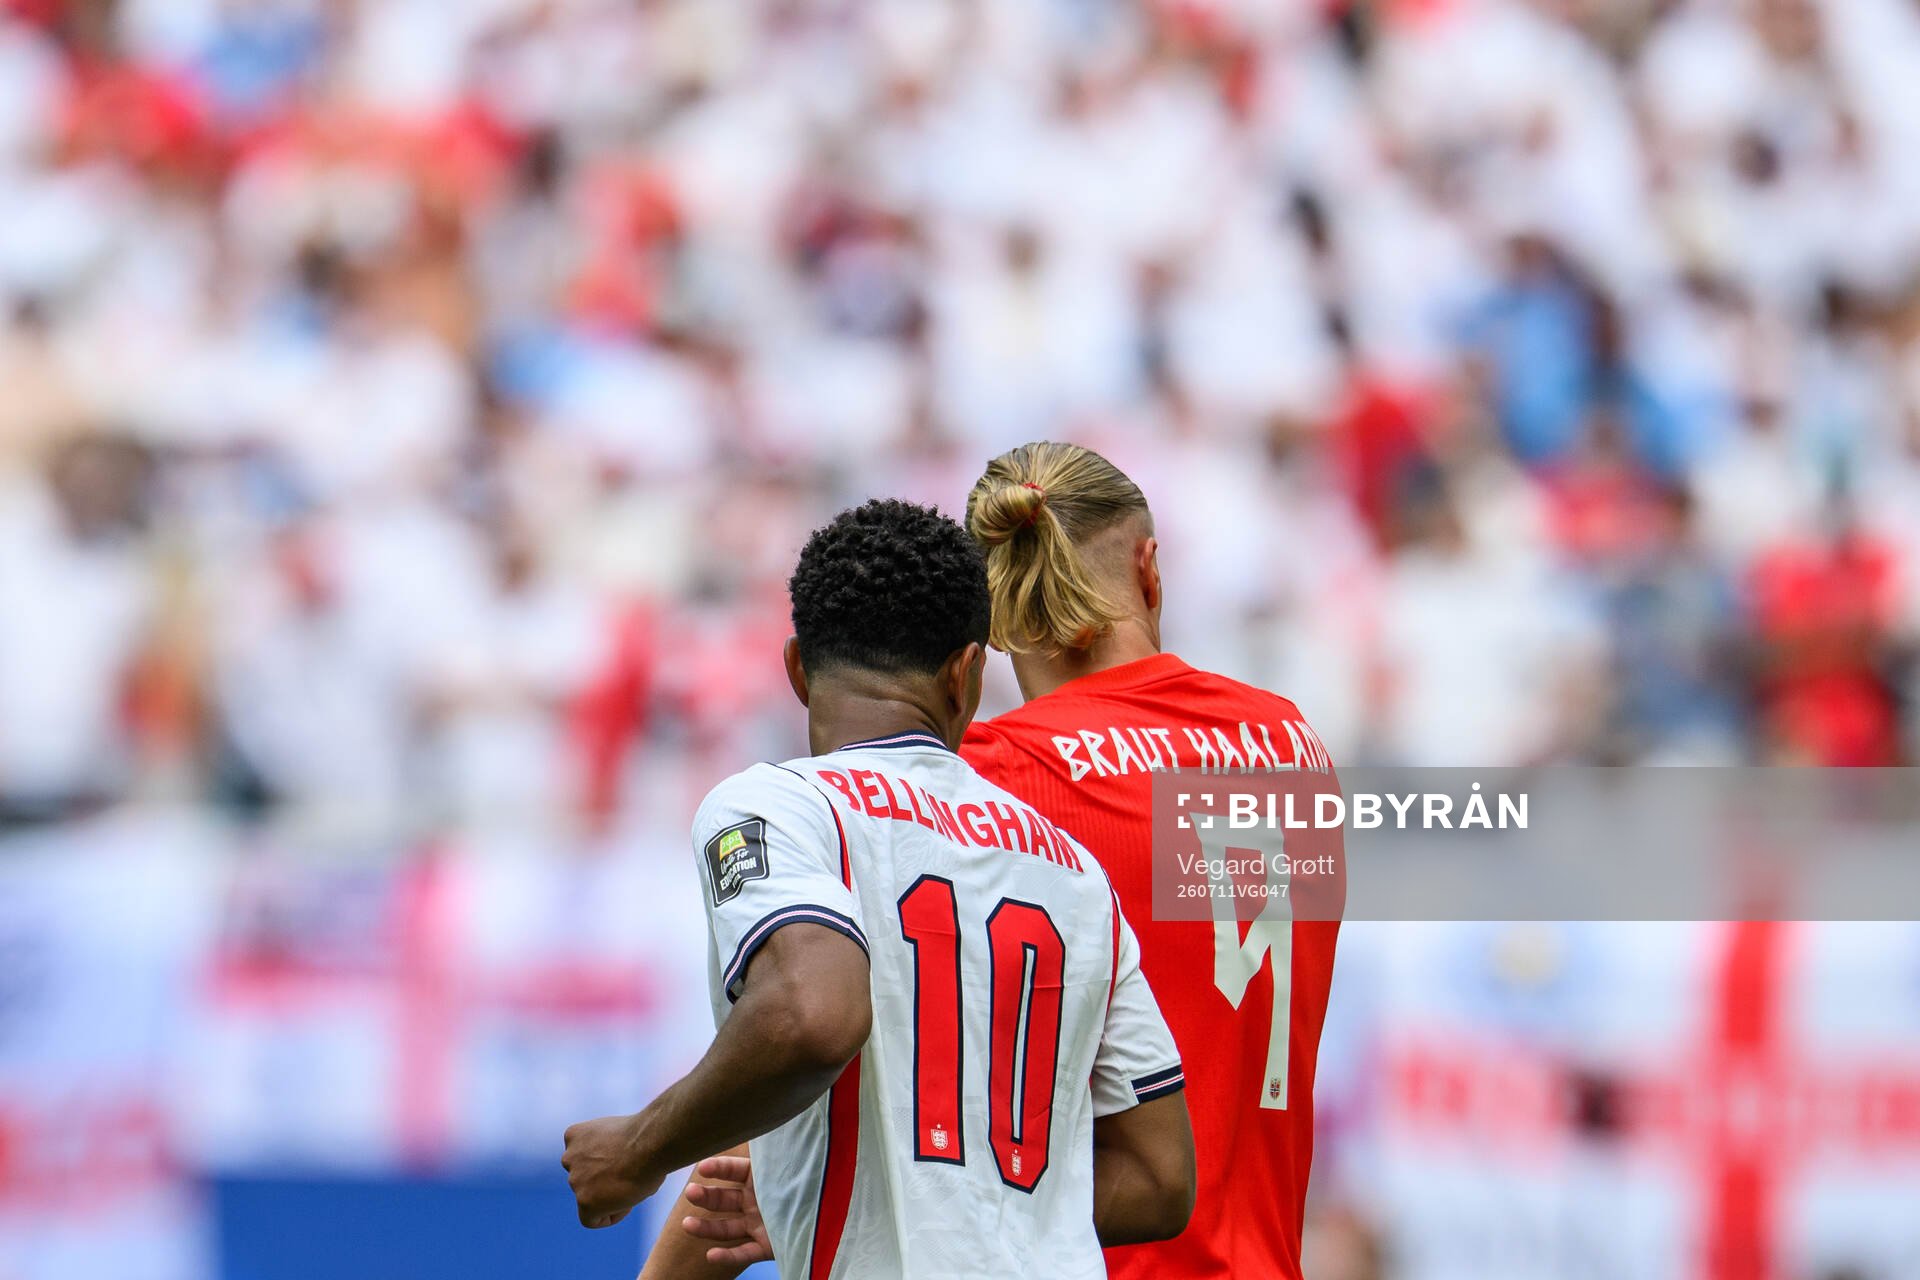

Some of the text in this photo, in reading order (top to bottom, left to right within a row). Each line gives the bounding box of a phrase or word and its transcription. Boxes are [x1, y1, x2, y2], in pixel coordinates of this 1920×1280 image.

[1051, 727, 1181, 781] BRAUT
[720, 857, 757, 891] EDUCATION
[816, 768, 1084, 874] BELLINGHAM
[1188, 812, 1293, 1111] 9
[897, 873, 1066, 1194] 10
